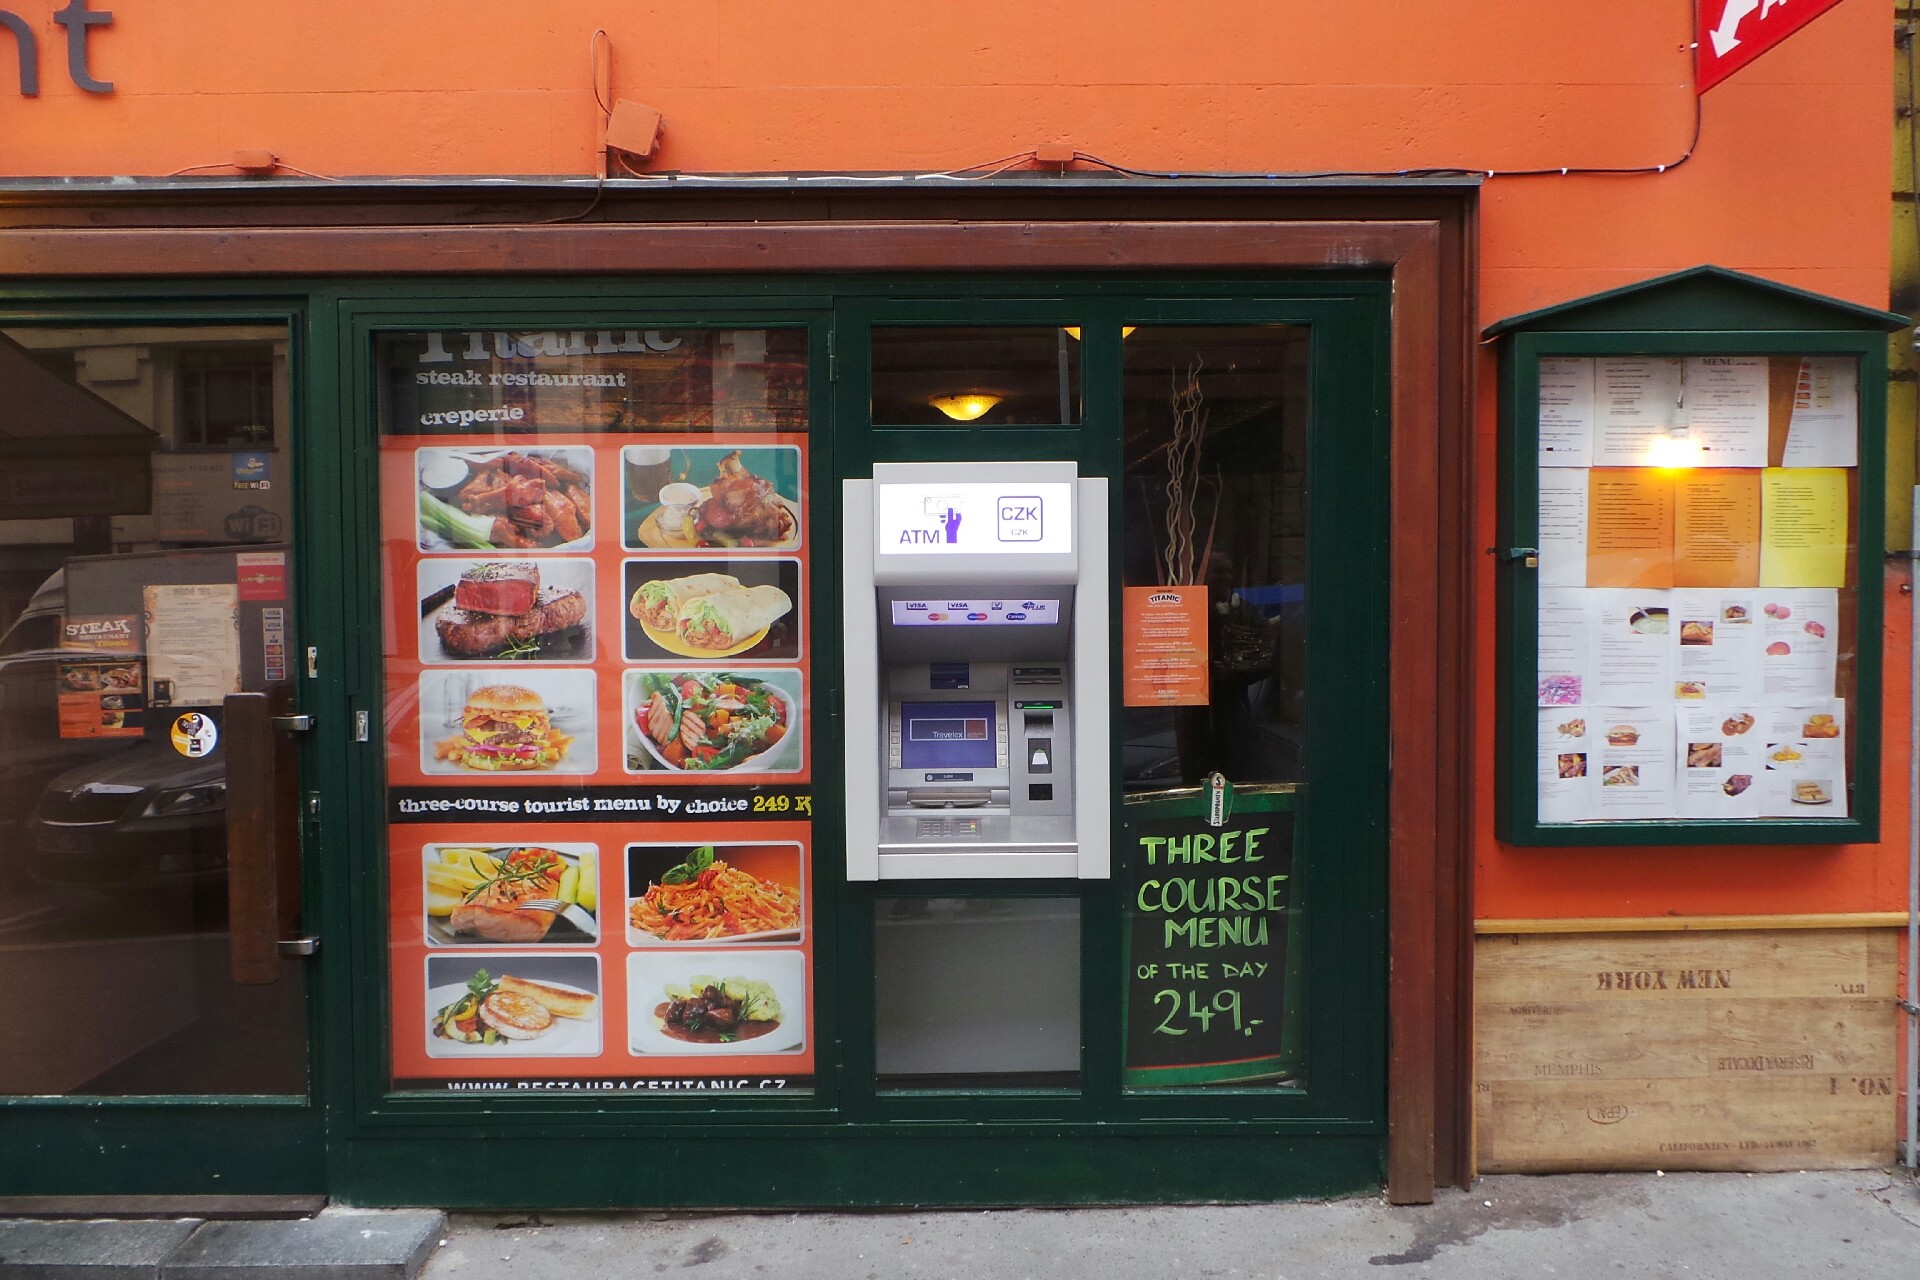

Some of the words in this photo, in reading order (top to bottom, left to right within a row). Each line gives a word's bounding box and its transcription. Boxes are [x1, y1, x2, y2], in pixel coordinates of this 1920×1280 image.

[416, 369, 483, 386] steak
[489, 371, 626, 387] restaurant
[420, 404, 524, 427] creperie
[1002, 507, 1038, 520] CZK
[900, 529, 940, 544] ATM
[1150, 595, 1181, 603] TITANIC
[66, 619, 131, 636] STEAK
[933, 731, 963, 739] Travelex
[399, 797, 520, 816] three-course
[524, 796, 591, 813] tourist
[594, 797, 653, 812] menu
[657, 794, 685, 814] by
[686, 796, 749, 815] choice
[754, 796, 791, 813] 249
[1139, 828, 1270, 865] THREE
[1137, 875, 1289, 914] COURSE
[1164, 916, 1269, 948] MENU
[1137, 964, 1159, 980] OF
[1166, 963, 1209, 980] THE
[1221, 961, 1268, 979] DAY
[1595, 970, 1668, 991] YORK
[1676, 969, 1731, 989] NEW
[1153, 989, 1264, 1037] 249.-
[1533, 1064, 1604, 1077] MEMPHIS
[1851, 1077, 1892, 1097] NO.
